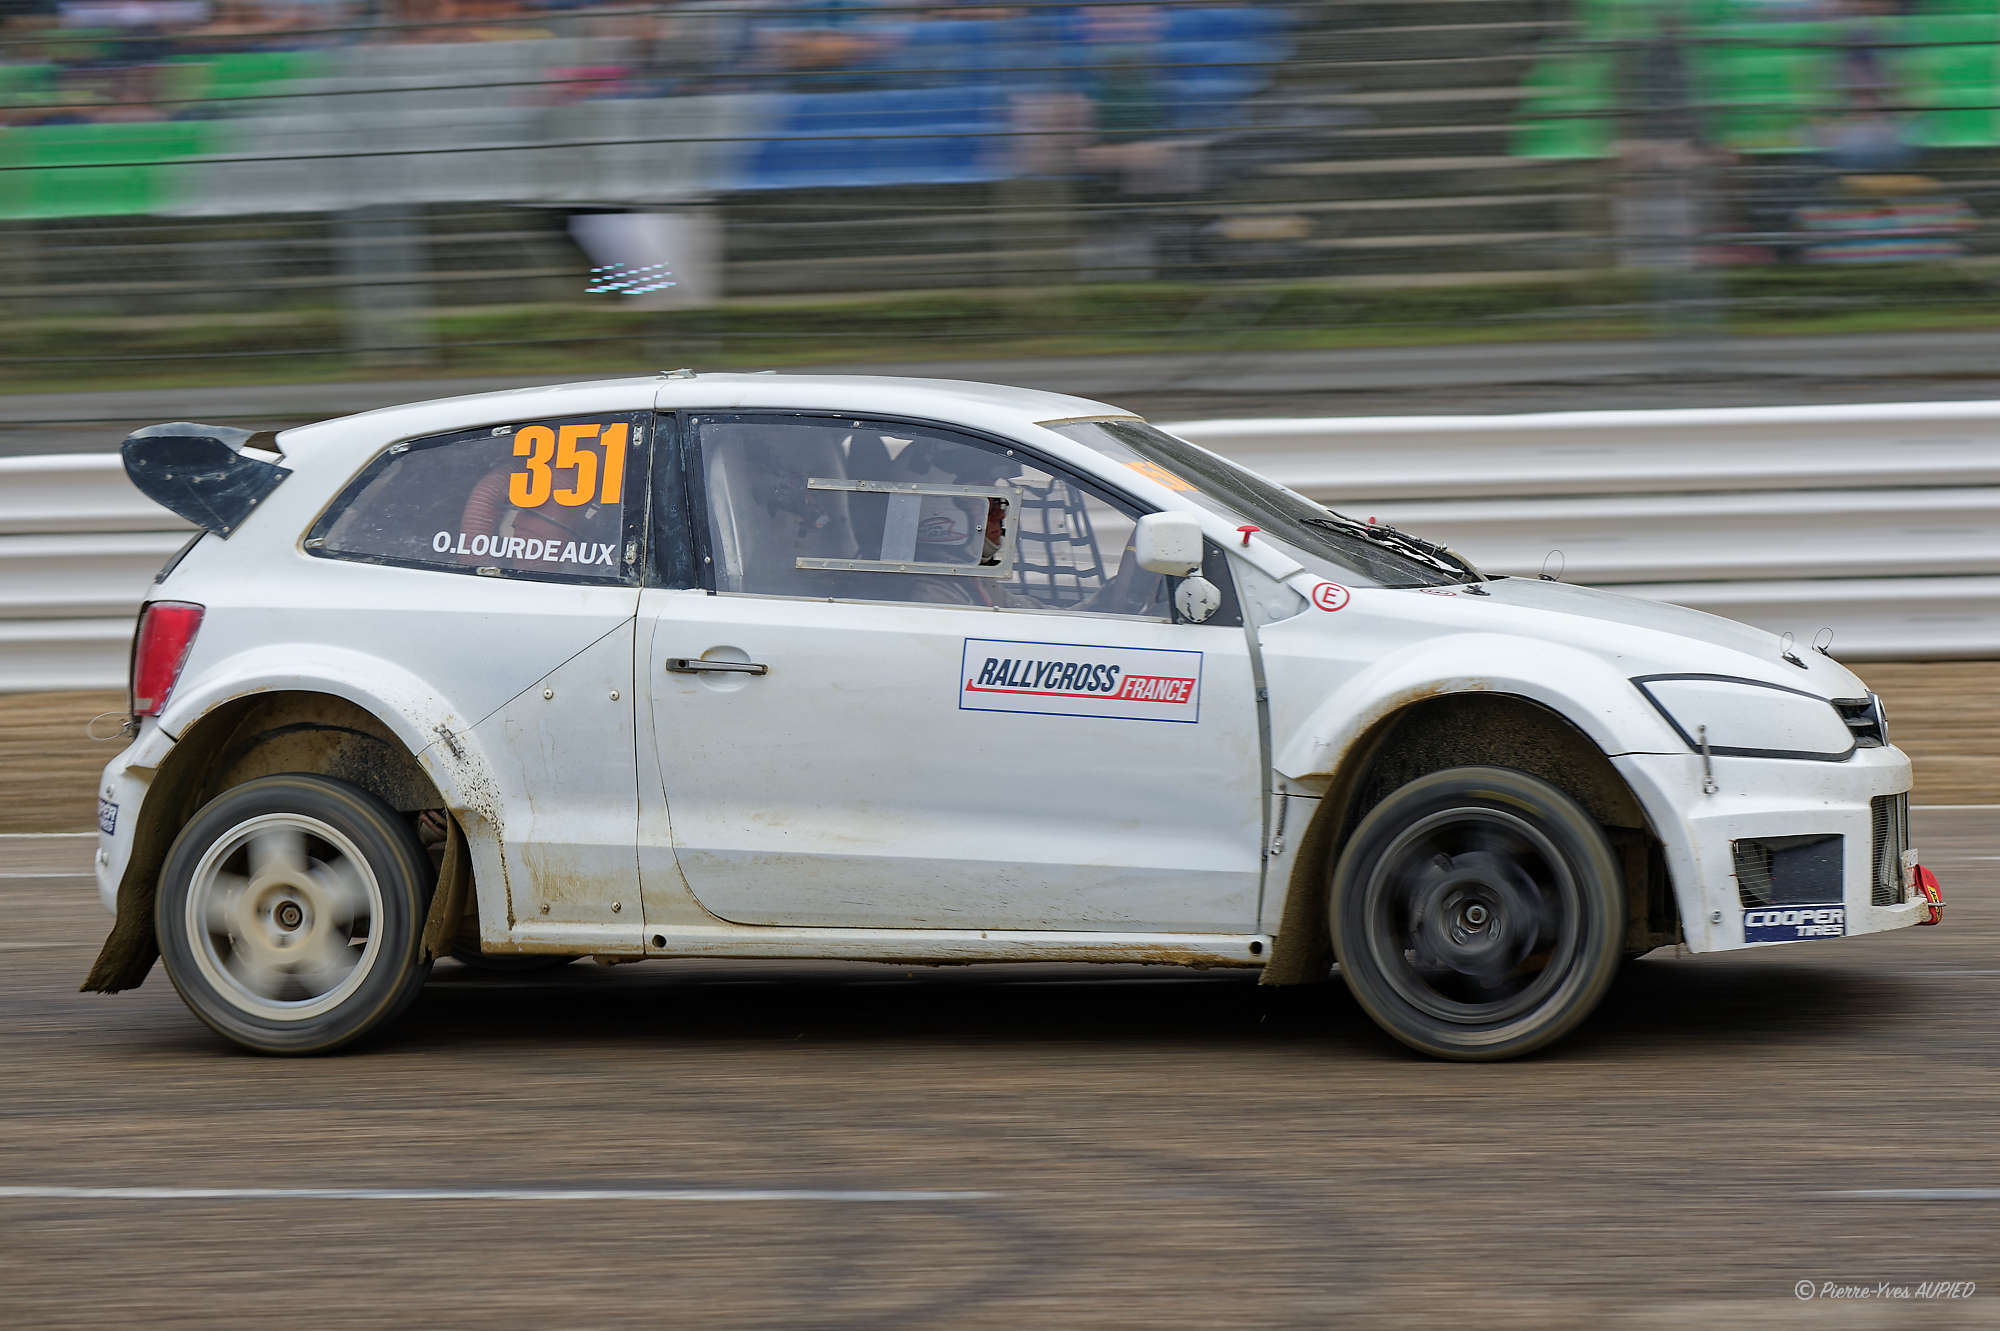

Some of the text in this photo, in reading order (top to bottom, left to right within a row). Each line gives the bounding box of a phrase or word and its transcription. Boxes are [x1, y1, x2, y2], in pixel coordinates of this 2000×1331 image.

[508, 422, 629, 508] 351
[432, 531, 616, 566] O.LOURDEAUX
[1321, 586, 1340, 605] E
[977, 657, 1192, 702] RALLYCROSS FRANCE
[1744, 908, 1844, 927] COOPER
